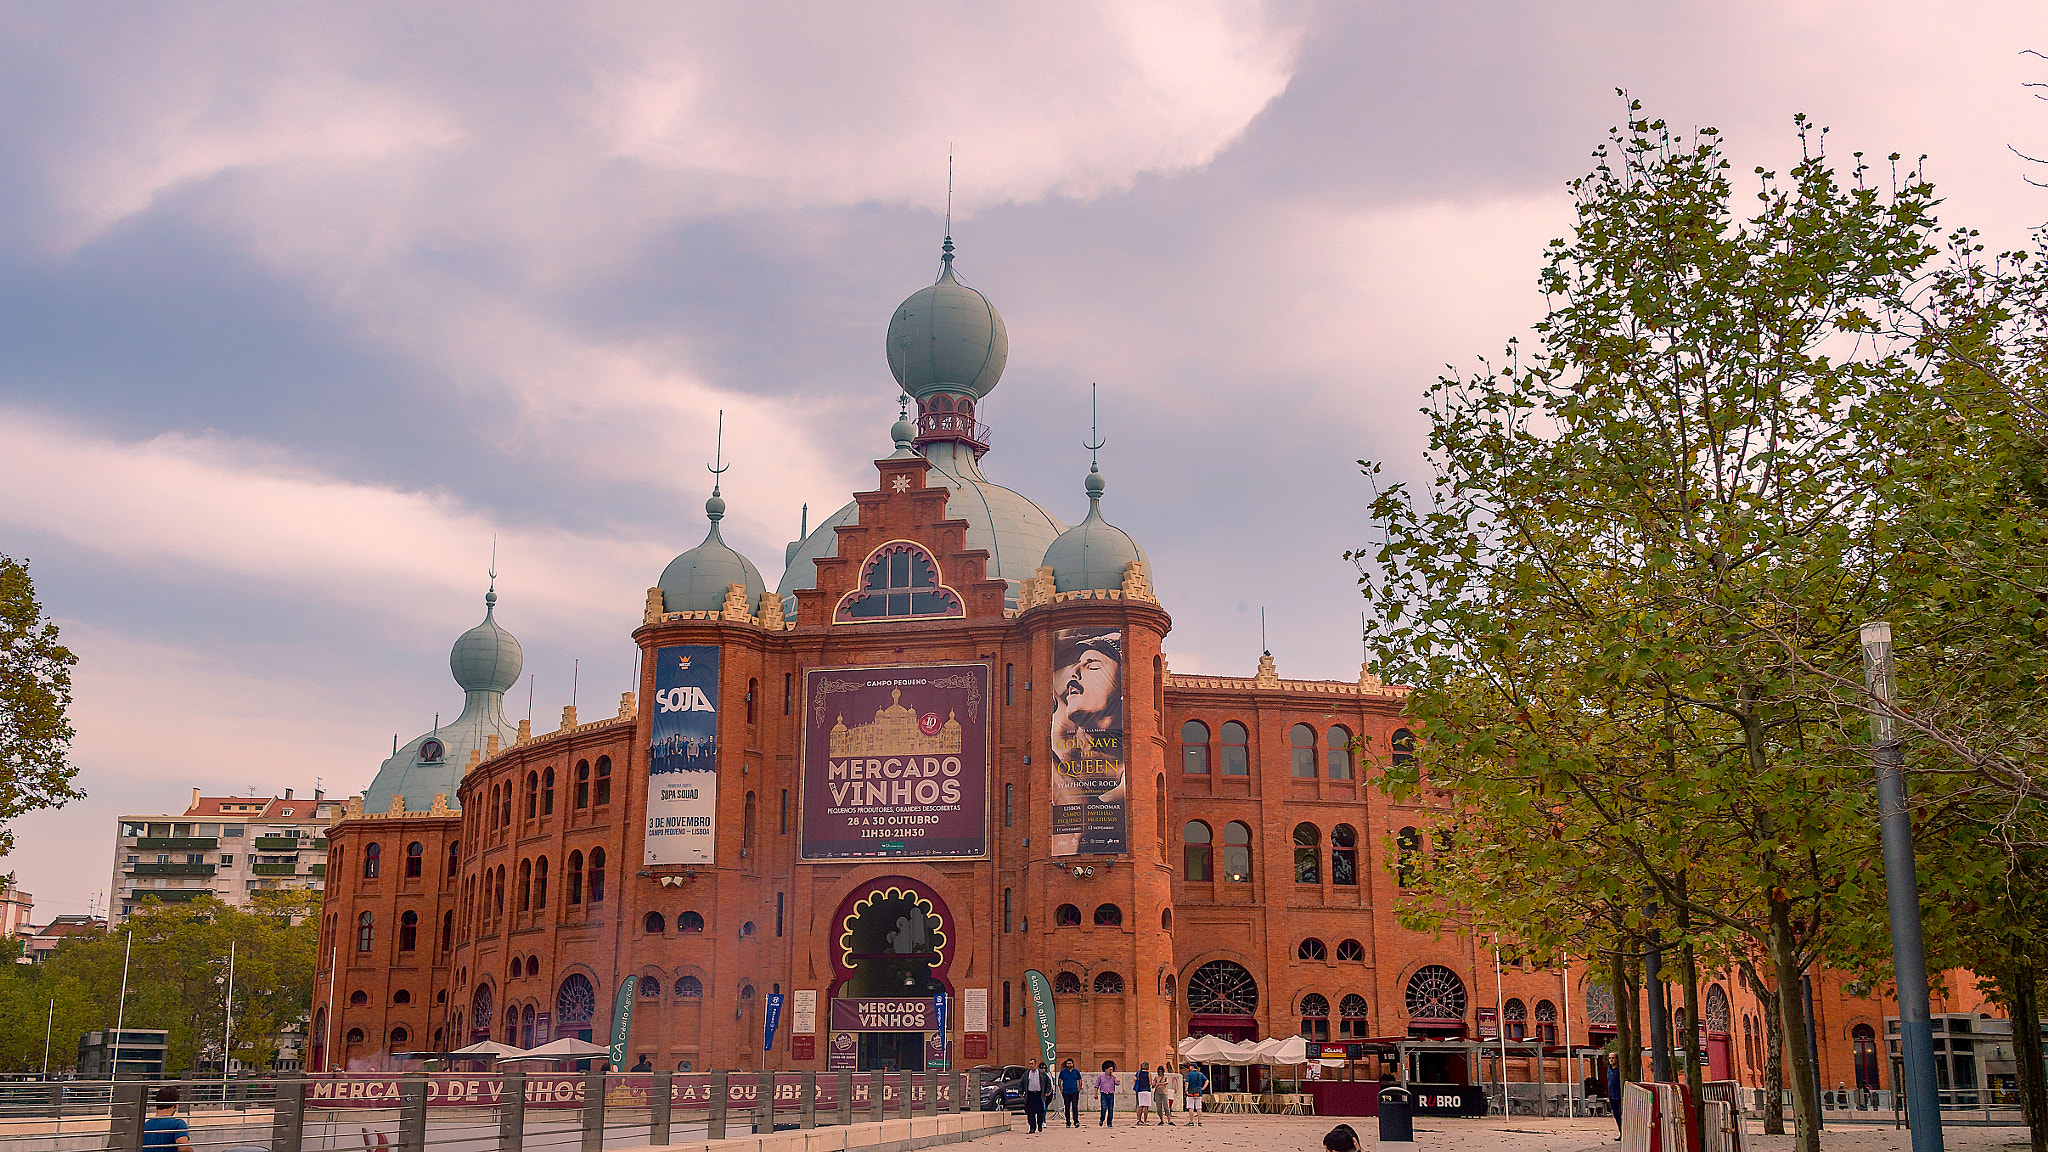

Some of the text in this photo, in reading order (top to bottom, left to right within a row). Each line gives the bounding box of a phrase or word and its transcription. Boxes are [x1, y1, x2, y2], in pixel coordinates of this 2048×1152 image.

[656, 686, 716, 713] SOJA
[1057, 738, 1117, 749] GOD SAVE
[829, 756, 961, 780] MERCADO
[1058, 760, 1118, 777] QUEEN
[828, 779, 961, 806] VINHOS
[649, 817, 710, 828] 3 DE NOVEMBRO
[848, 815, 939, 826] 28 A 30 OUTUBRO
[861, 829, 925, 838] 11H30-21H30
[858, 1002, 926, 1013] MERCADO
[613, 980, 633, 1062] CA Crédito Agrícola
[858, 1014, 925, 1027] VINHOS
[313, 1082, 439, 1101] MERCAO
[447, 1081, 479, 1101] DE
[683, 1085, 696, 1100] A
[1419, 1095, 1461, 1107] RUBRO
